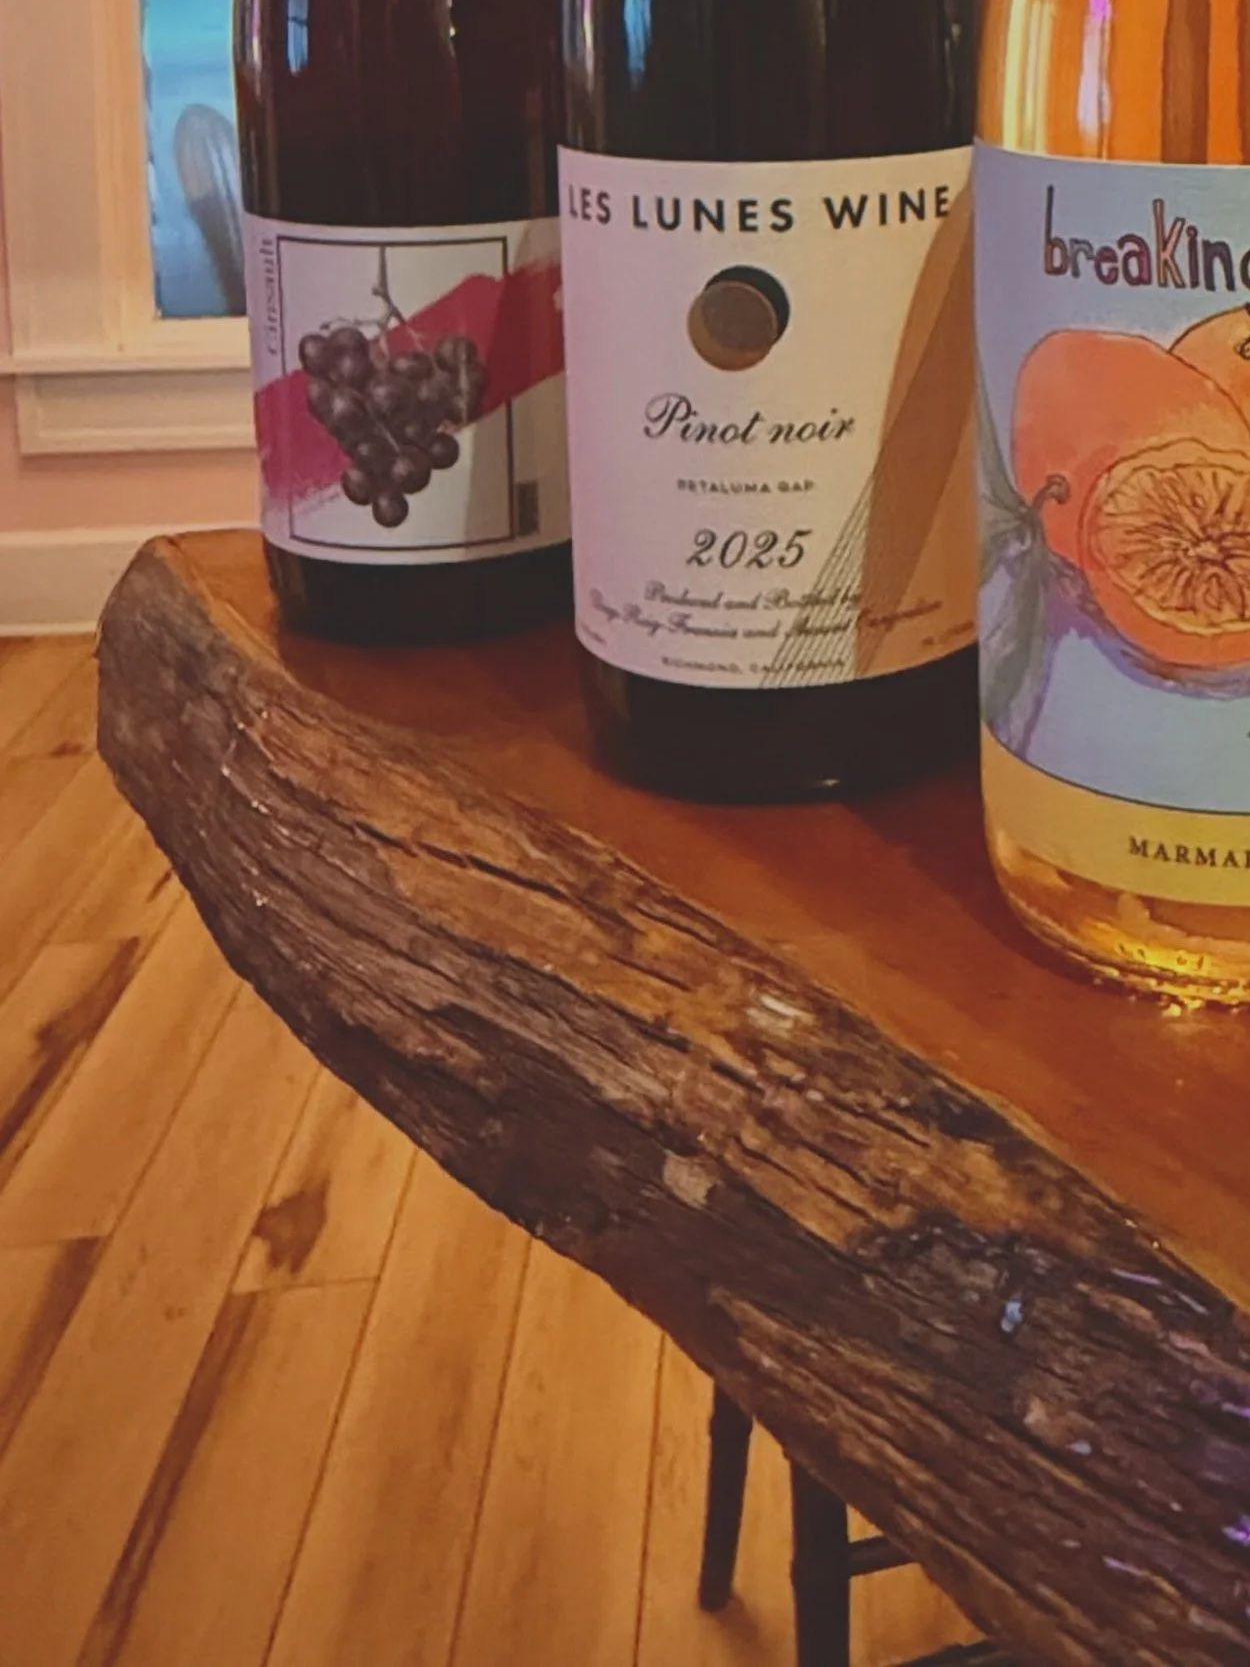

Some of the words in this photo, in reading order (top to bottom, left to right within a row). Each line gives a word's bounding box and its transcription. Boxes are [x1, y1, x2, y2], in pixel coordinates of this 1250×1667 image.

[568, 184, 612, 225] LES
[631, 195, 795, 233] LUNES
[823, 185, 951, 230] WINE
[643, 391, 763, 445] Pinot
[769, 406, 855, 445] noir
[685, 528, 813, 570] 2025
